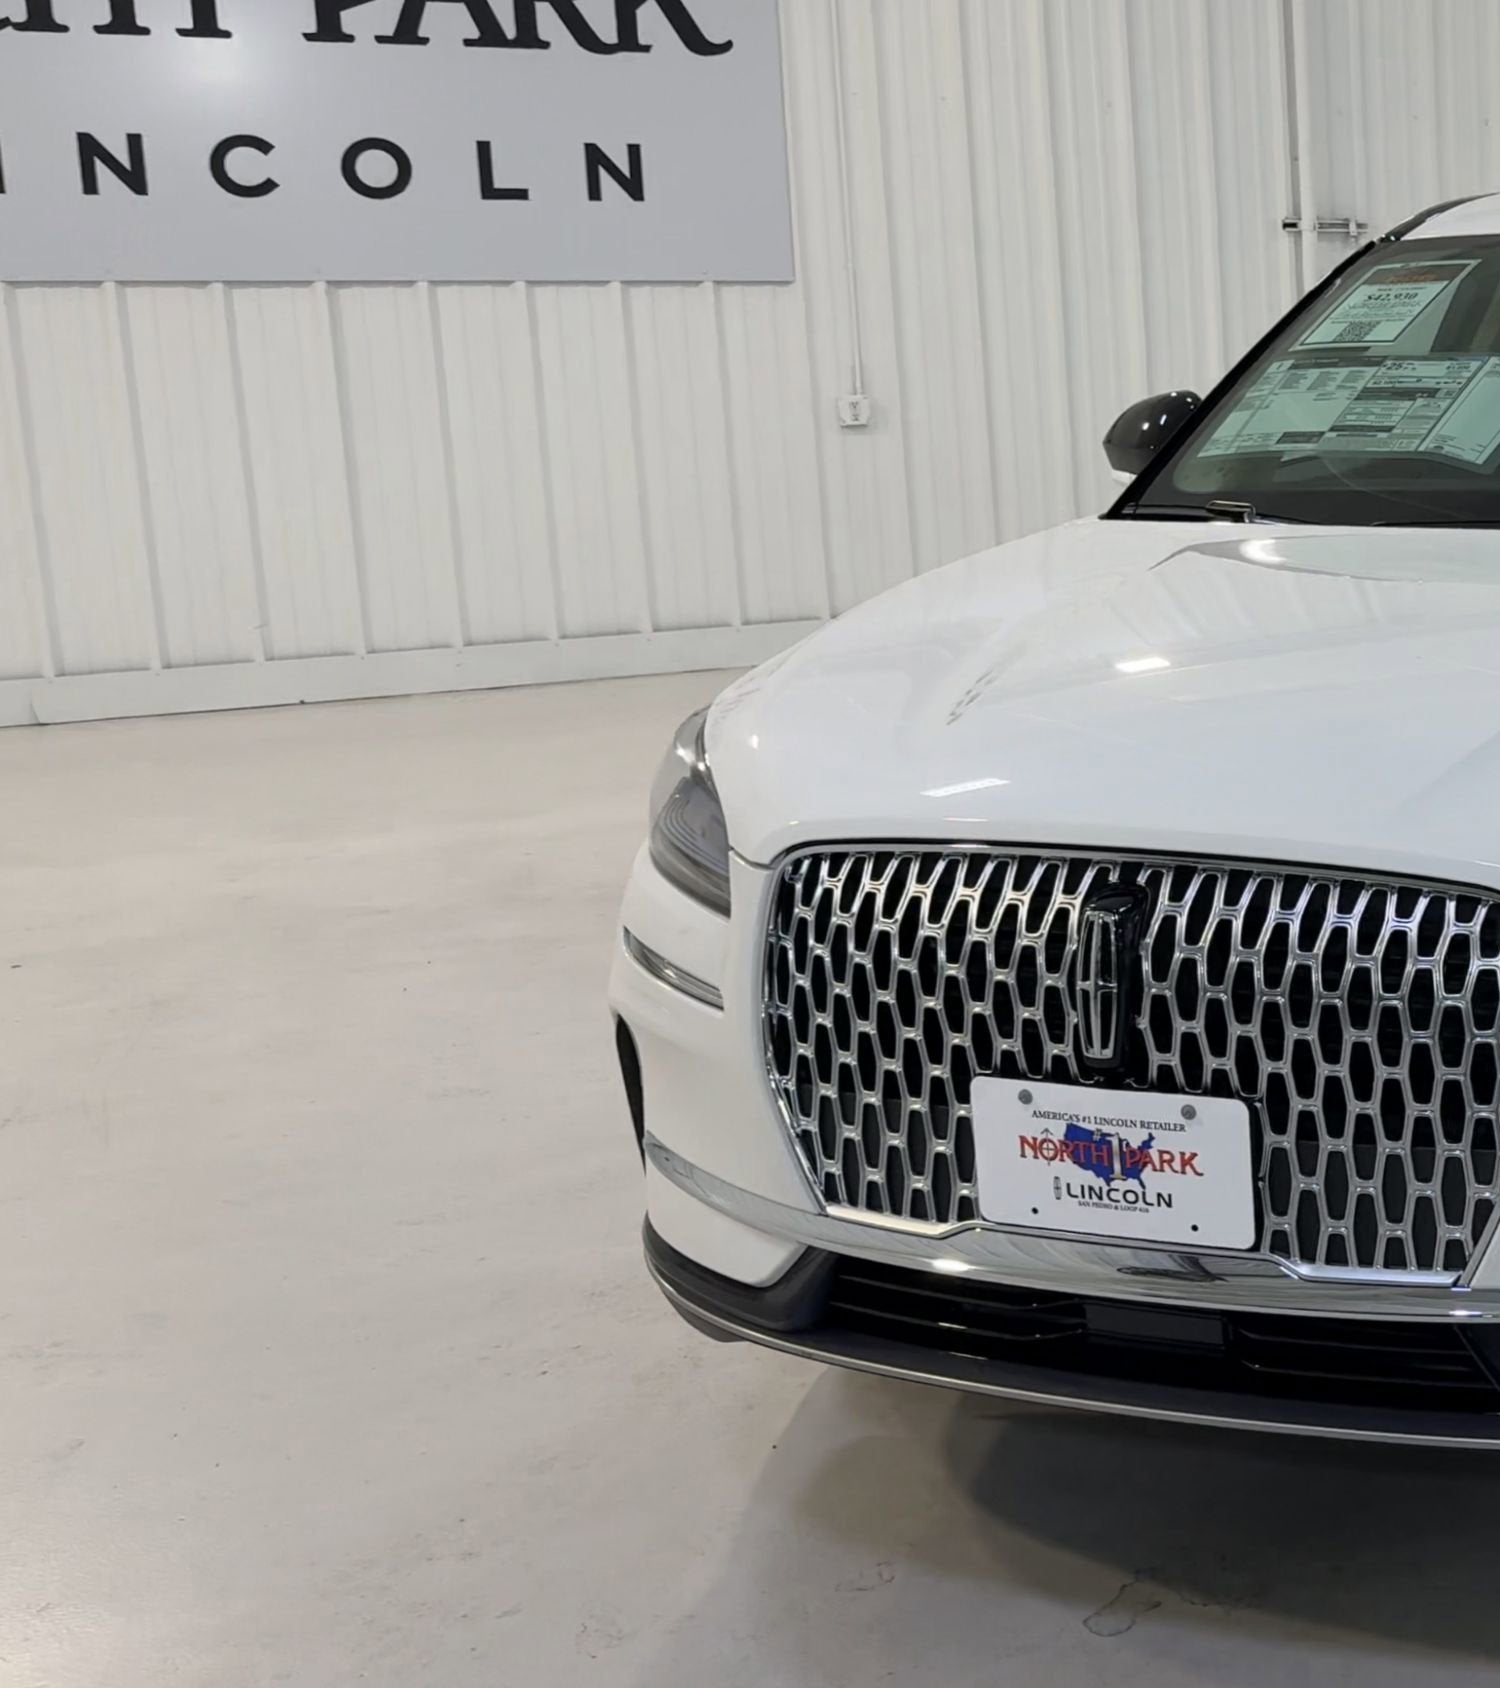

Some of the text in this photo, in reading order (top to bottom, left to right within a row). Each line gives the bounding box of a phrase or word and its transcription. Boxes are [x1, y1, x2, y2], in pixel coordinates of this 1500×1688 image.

[1032, 1110, 1186, 1132] AMERICA'S #1 LINCOLN RETAILER
[1018, 1134, 1204, 1177] NORTH PARK
[1066, 1183, 1174, 1209] LINCOLN
